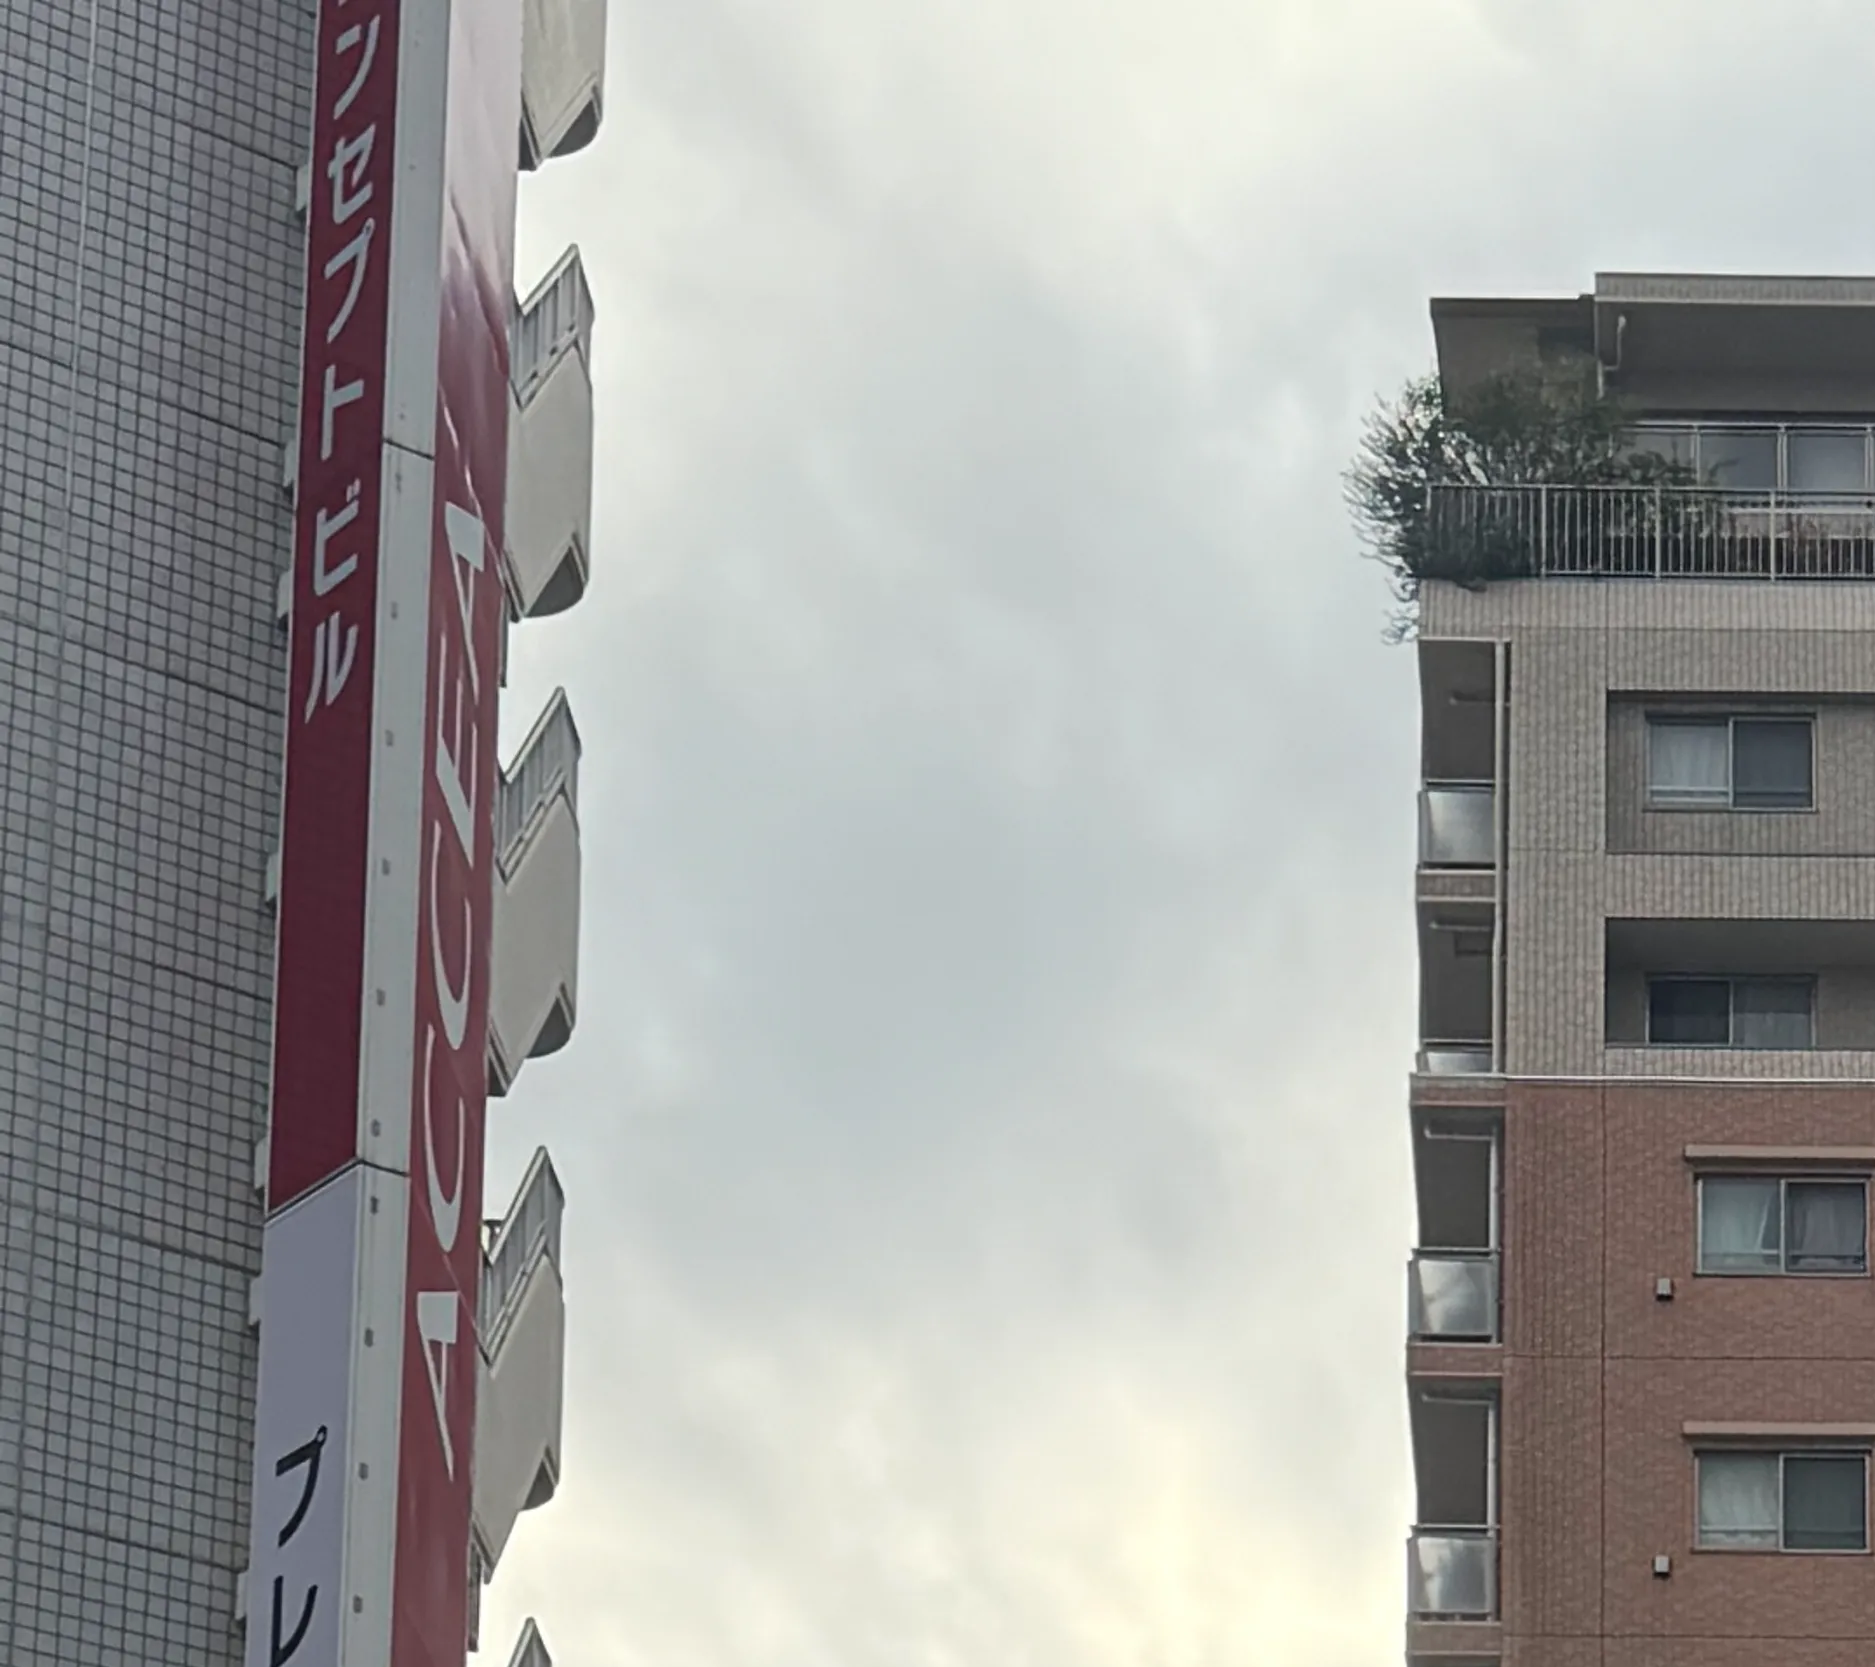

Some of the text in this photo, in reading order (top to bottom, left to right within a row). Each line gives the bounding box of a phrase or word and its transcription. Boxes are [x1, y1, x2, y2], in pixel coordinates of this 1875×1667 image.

[305, 0, 382, 724] ンセプトビル
[416, 501, 485, 1482] ACCEA
